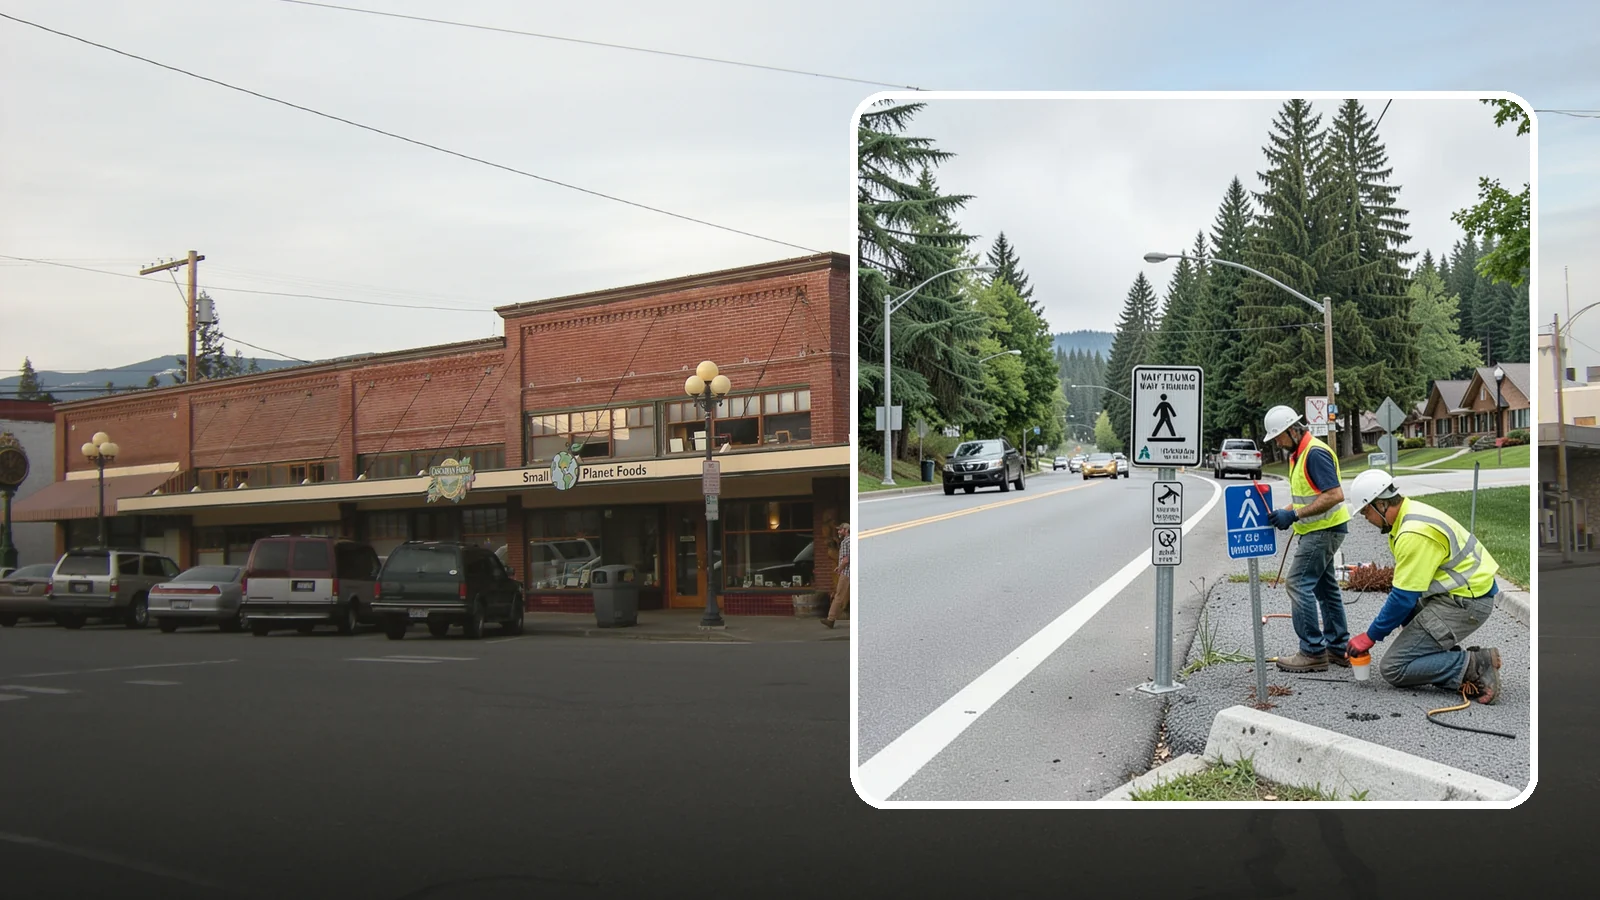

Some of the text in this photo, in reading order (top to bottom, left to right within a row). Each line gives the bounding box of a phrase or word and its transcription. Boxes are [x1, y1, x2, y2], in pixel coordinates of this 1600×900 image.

[523, 464, 647, 482] Small Planet Foods
